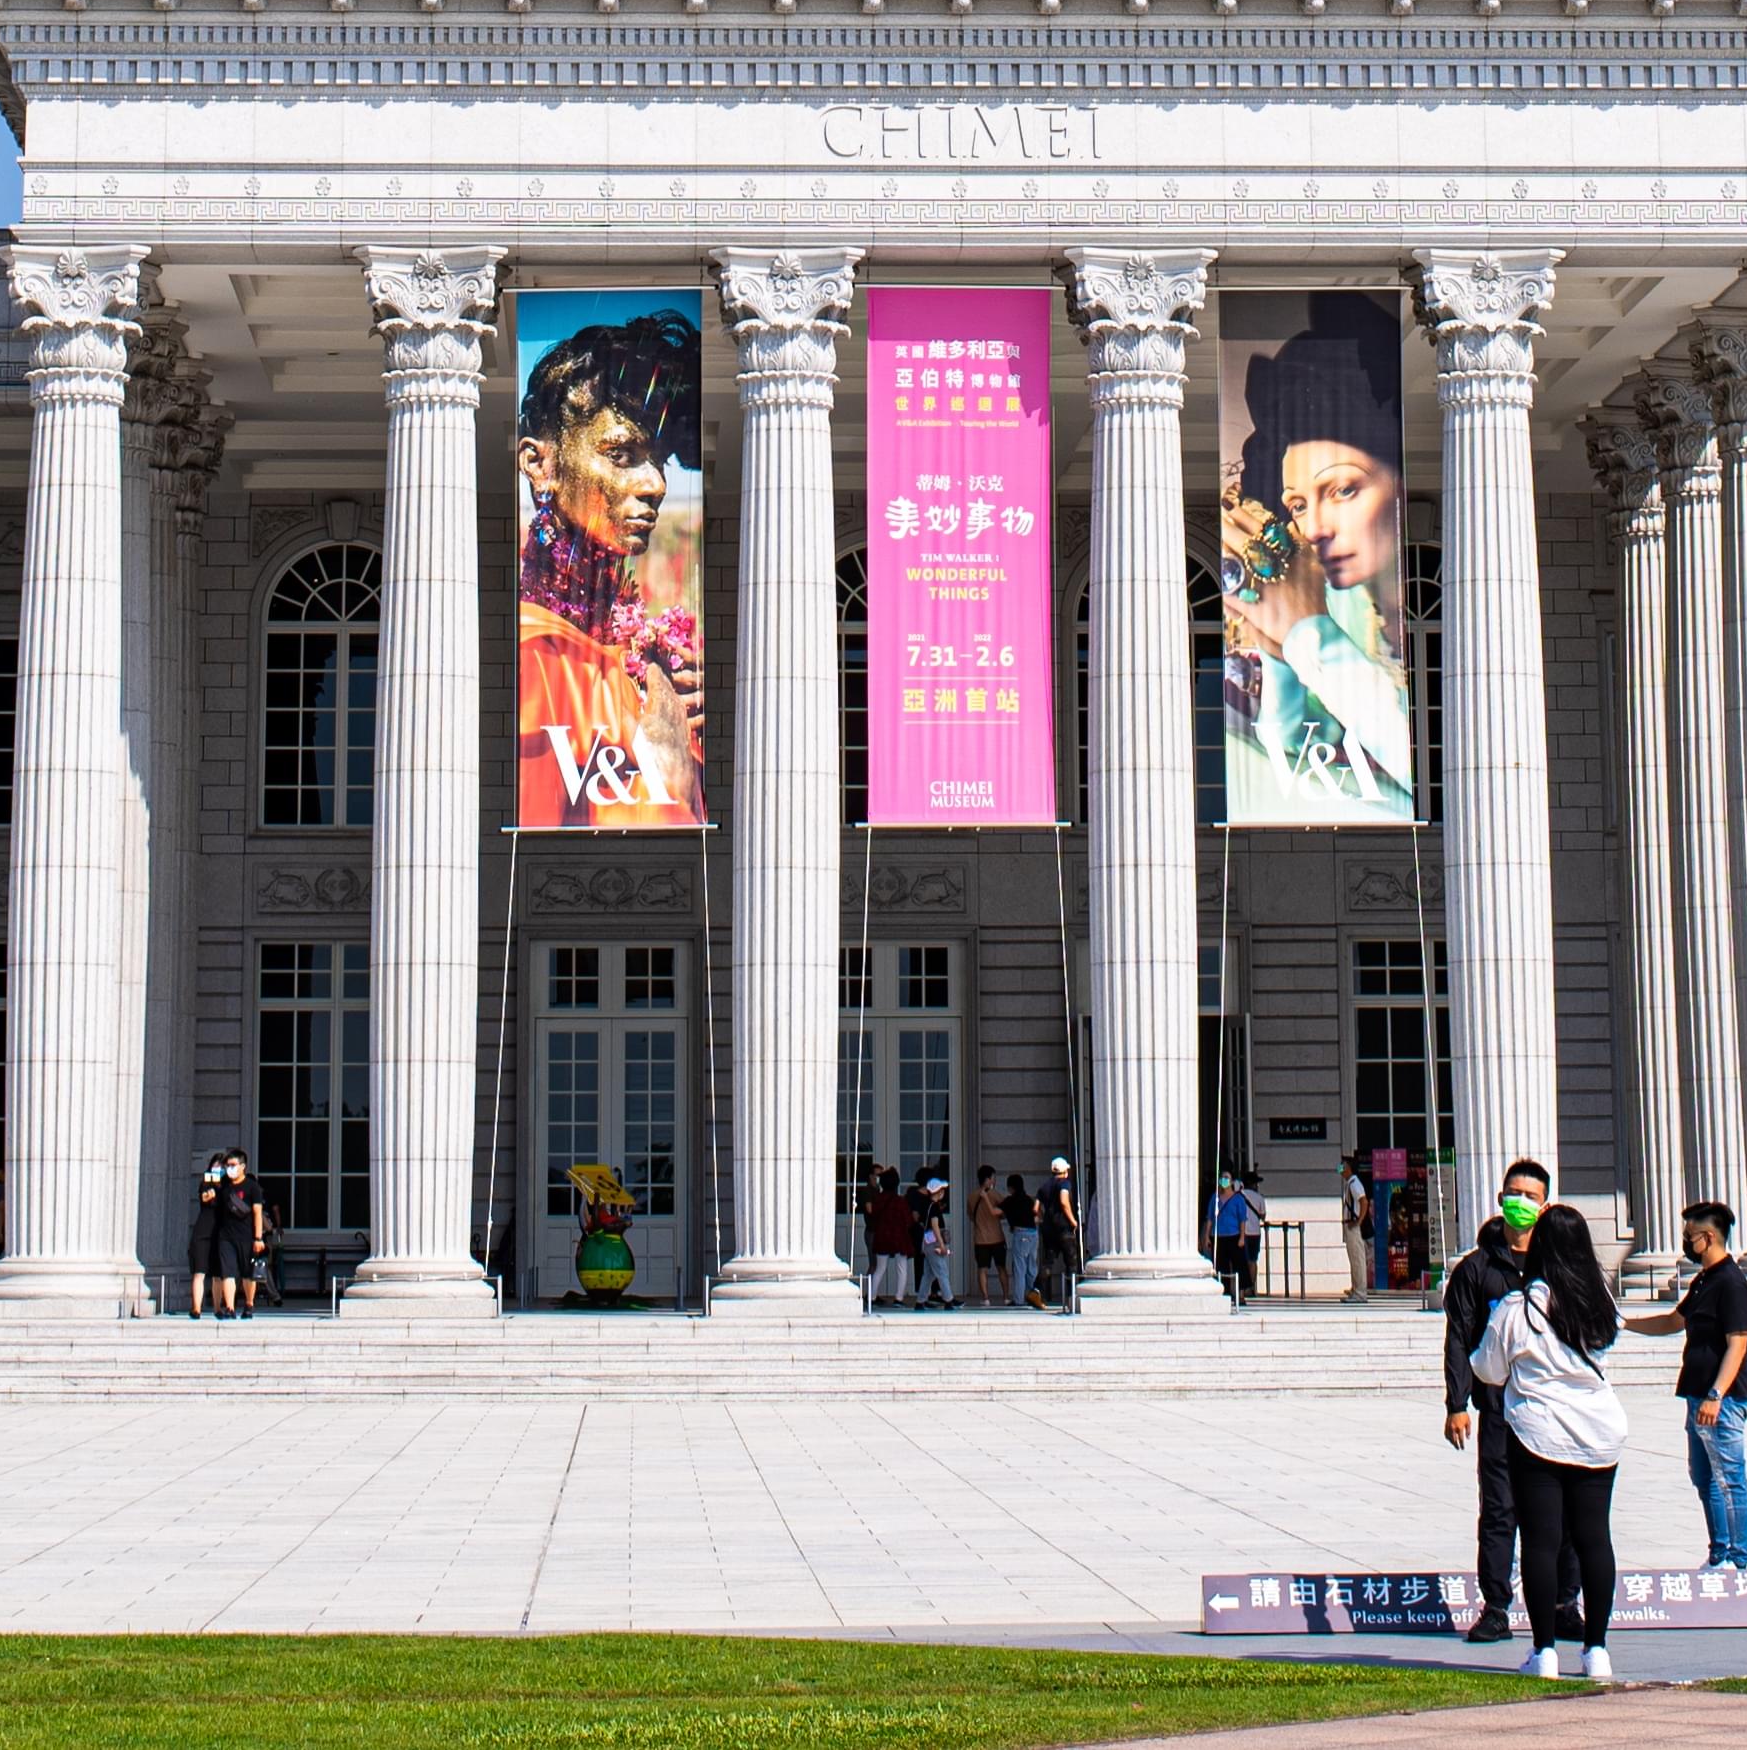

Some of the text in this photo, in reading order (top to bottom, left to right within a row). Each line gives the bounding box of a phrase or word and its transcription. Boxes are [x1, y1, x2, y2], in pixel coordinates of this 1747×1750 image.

[819, 106, 1102, 158] CHIMEI
[884, 496, 1035, 540] 美妙事物
[920, 553, 942, 563] TIM
[906, 567, 1008, 581] WONDERFUL
[929, 587, 990, 600] THINGS
[903, 688, 1020, 713] 亞洲首站
[539, 723, 679, 807] V&A
[1250, 721, 1390, 802] V&A
[929, 780, 993, 795] CHIMEI
[929, 796, 995, 808] MUSEUM
[1352, 1610, 1402, 1624] Please
[1408, 1610, 1446, 1627] keep
[1451, 1609, 1474, 1624] off
